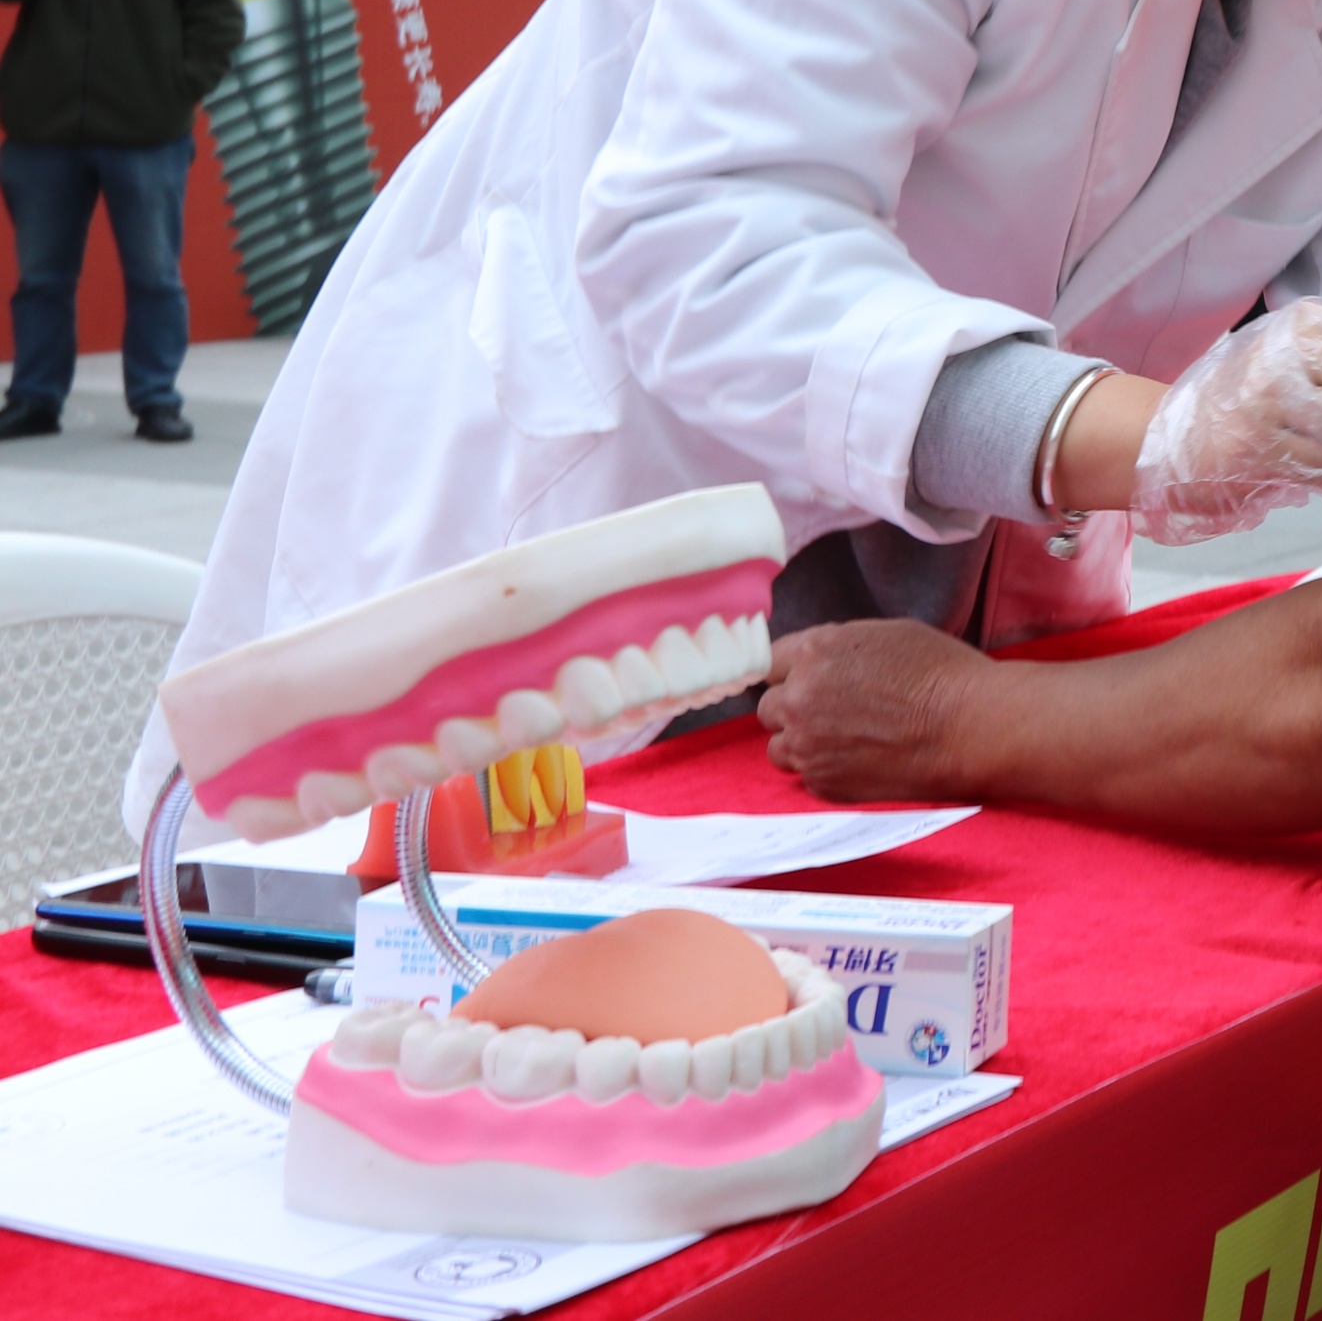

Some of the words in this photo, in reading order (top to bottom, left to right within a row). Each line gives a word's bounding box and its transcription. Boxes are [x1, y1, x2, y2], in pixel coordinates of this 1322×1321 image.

[820, 944, 899, 975] 牙博士
[970, 943, 988, 1052] Doctor
